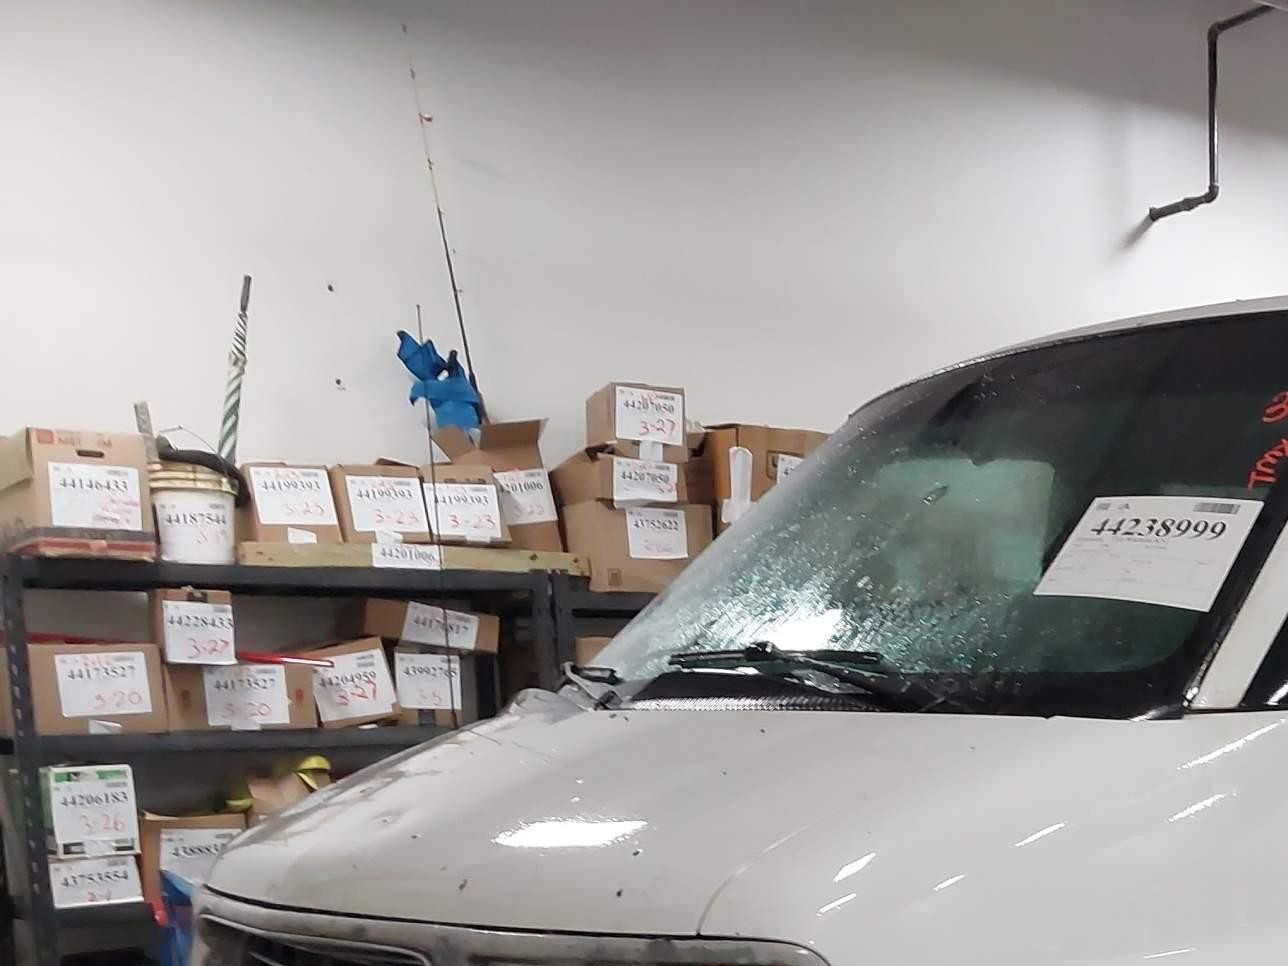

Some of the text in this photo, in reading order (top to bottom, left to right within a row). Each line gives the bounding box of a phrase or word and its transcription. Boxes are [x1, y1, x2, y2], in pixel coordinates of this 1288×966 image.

[622, 399, 675, 413] 44207050
[639, 418, 676, 437] 3-27
[58, 476, 129, 493] 44146433
[165, 511, 227, 526] 44187544
[632, 518, 679, 531] 43752622
[1091, 518, 1227, 541] 44238999
[167, 614, 234, 629] 44228433
[67, 665, 136, 681] 44173527
[212, 677, 276, 691] 44173527
[60, 792, 129, 808] 44206183
[60, 870, 130, 888] 43753554
